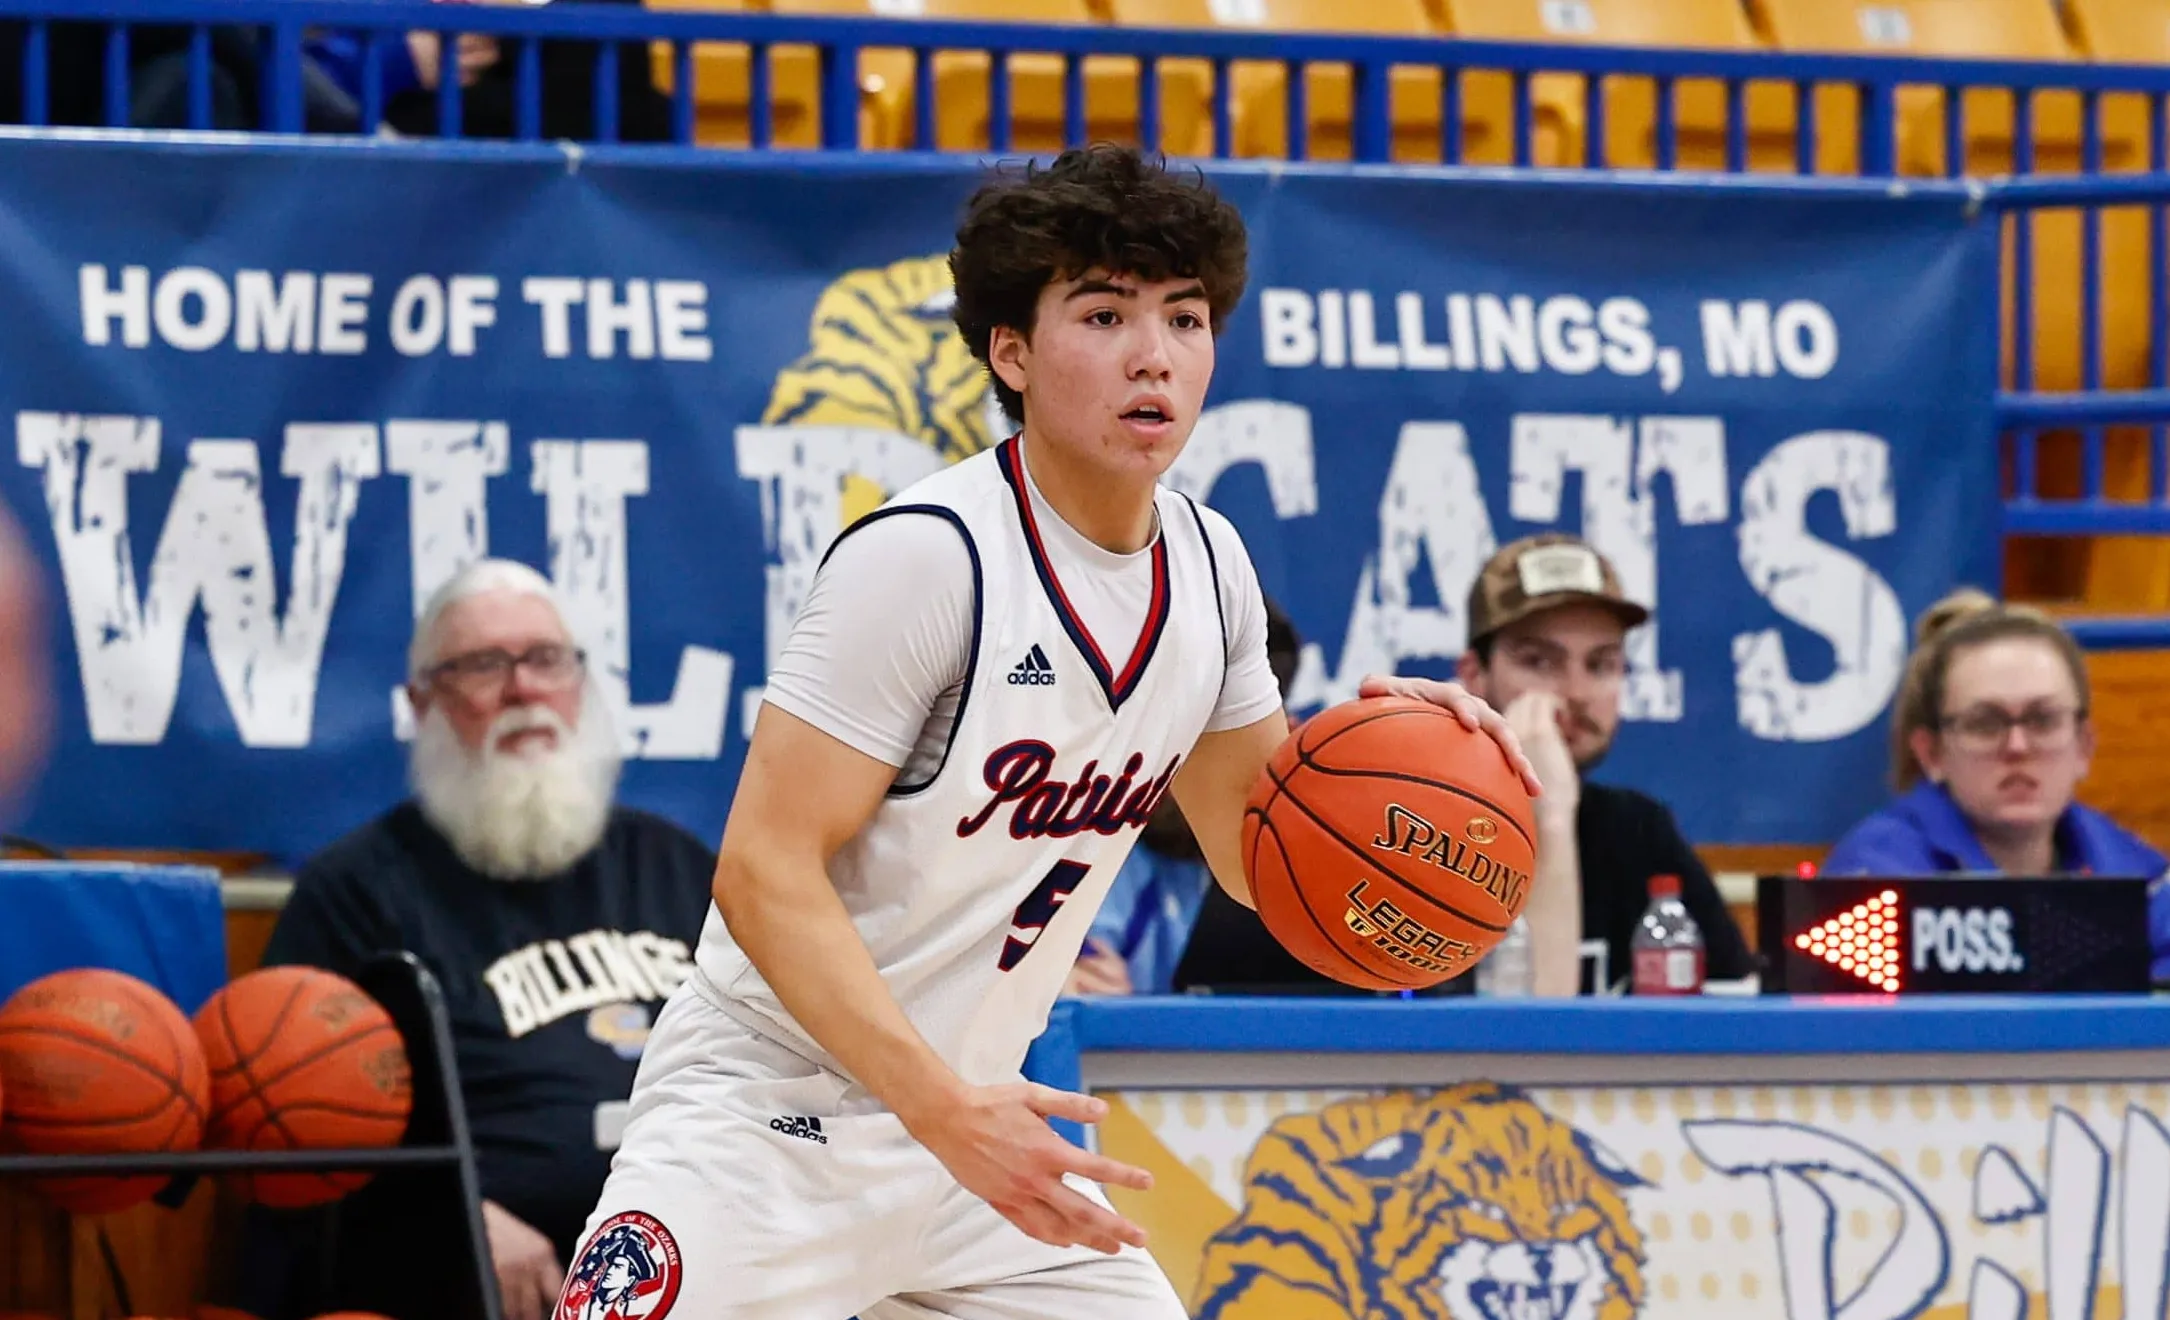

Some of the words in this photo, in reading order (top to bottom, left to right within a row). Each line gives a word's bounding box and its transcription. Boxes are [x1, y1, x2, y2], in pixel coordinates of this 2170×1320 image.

[79, 264, 373, 354] HOME
[390, 274, 498, 357] OF
[522, 276, 713, 362] THE
[1261, 287, 1683, 394] BILLINGS,
[1701, 300, 1839, 379] MO
[1007, 670, 1056, 686] adidas
[1371, 803, 1528, 919] SPALDING
[997, 858, 1092, 972] 5
[1346, 878, 1481, 961] LEGACY
[1911, 906, 2025, 974] POSS.
[770, 1118, 828, 1145] adidas
